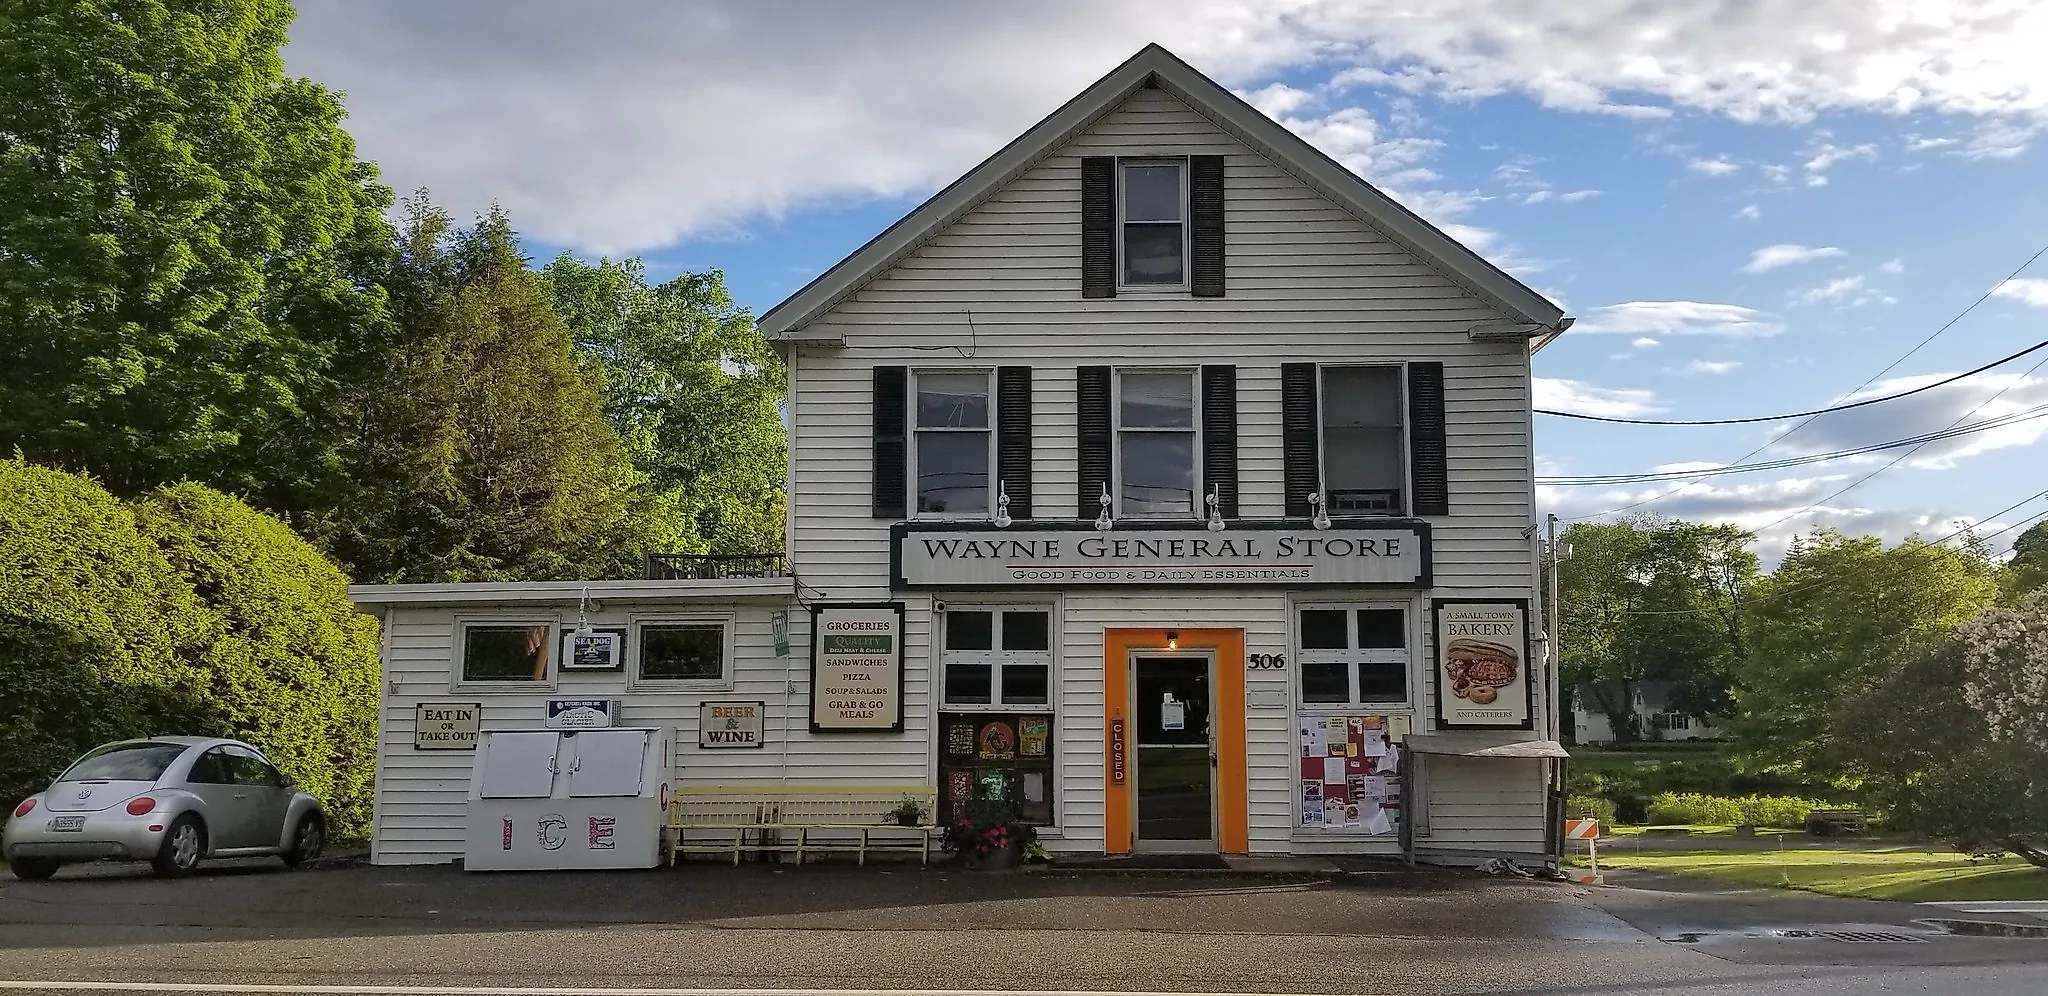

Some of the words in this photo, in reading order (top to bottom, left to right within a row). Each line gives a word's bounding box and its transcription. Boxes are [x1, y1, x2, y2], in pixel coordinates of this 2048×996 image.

[921, 538, 1060, 560] WAYNE
[1076, 536, 1262, 560] GENERAL
[1276, 536, 1401, 560] STORE
[1012, 570, 1065, 580] GOOD
[1071, 570, 1120, 580] FOOD
[1126, 571, 1136, 580] &
[1142, 570, 1197, 580] DAILY
[1202, 569, 1311, 580] ESSENTIALS
[826, 621, 890, 631] GROCERIES
[1447, 623, 1514, 636] BAKERY
[593, 637, 611, 645] DOG
[835, 636, 881, 648] QUALITY
[826, 658, 888, 667] SANDWICHES
[1247, 653, 1285, 669] 506
[842, 673, 871, 681] PIZZA
[828, 700, 857, 709] GRAB
[858, 700, 867, 709] &
[868, 700, 884, 709] GO
[424, 709, 453, 721] EAT
[455, 709, 473, 721] IN
[711, 706, 756, 718] BEER
[839, 710, 874, 719] MEALS
[440, 722, 454, 730] OR
[725, 718, 740, 730] &
[418, 731, 450, 741] TAKE
[451, 731, 477, 741] OUT
[706, 731, 755, 743] WINE
[1113, 724, 1124, 780] CLOSED
[502, 813, 616, 850] ICE
